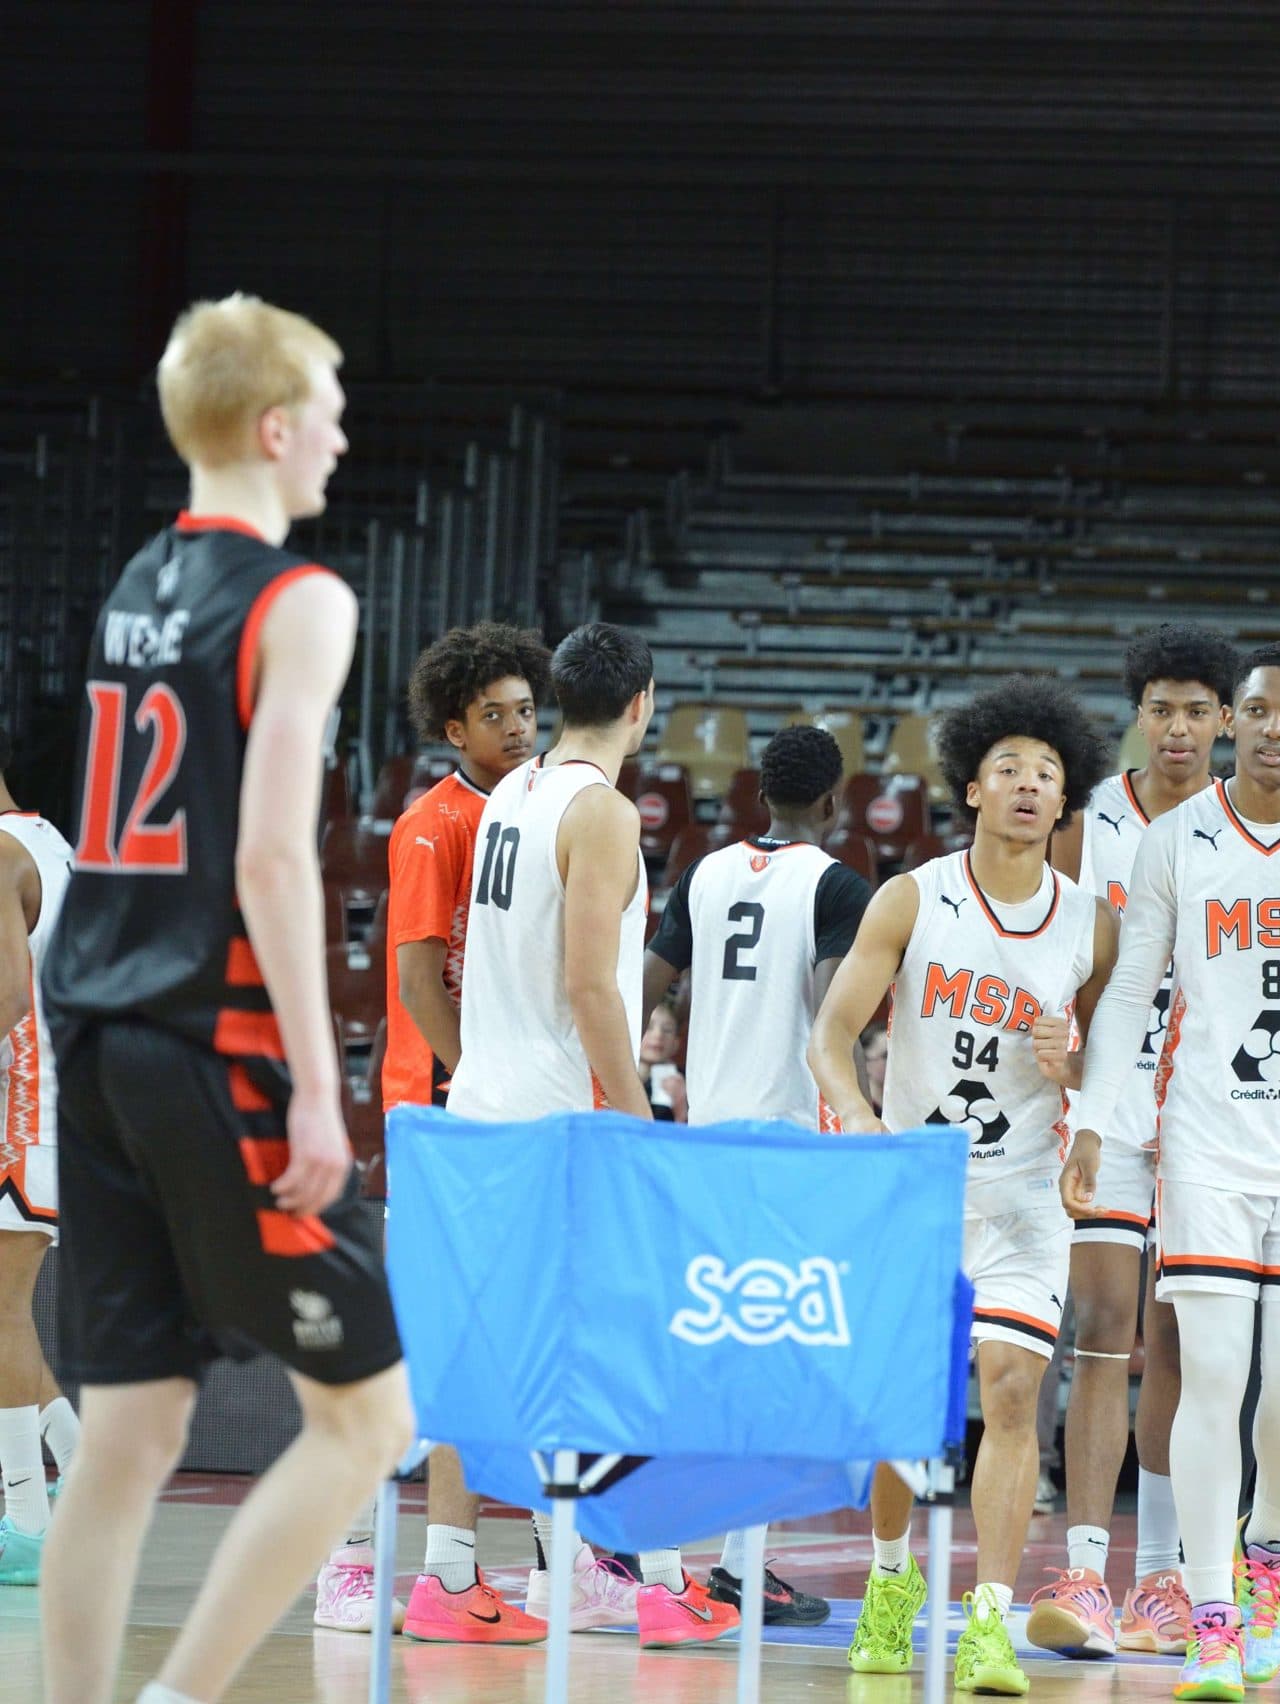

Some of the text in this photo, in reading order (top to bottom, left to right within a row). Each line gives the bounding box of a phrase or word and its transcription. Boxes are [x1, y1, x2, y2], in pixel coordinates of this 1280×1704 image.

[74, 680, 189, 876] 12
[475, 820, 521, 912] 10
[722, 900, 765, 981] 2
[920, 961, 1044, 1033] MSB
[951, 1029, 1000, 1073] 94
[1230, 1087, 1266, 1100] Crédit
